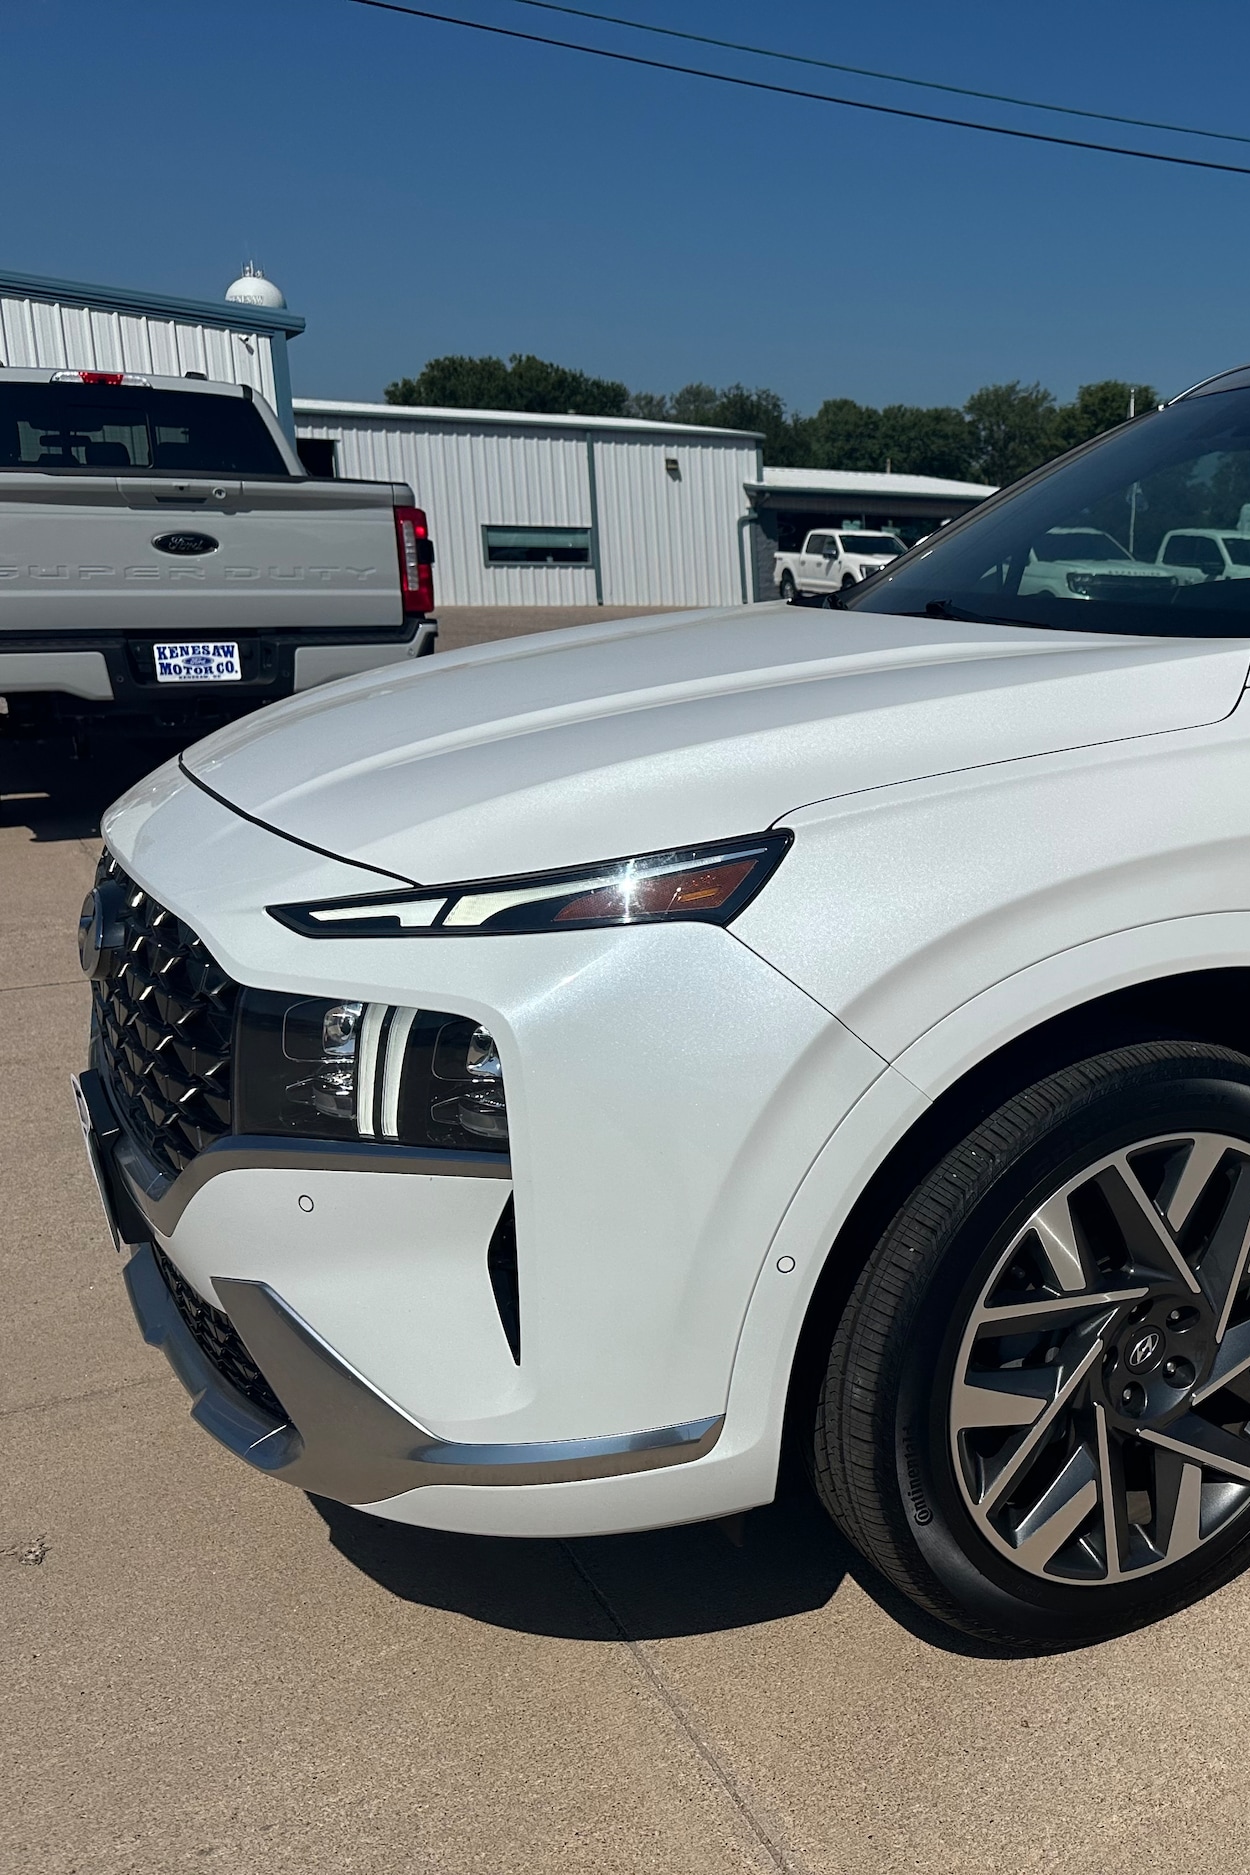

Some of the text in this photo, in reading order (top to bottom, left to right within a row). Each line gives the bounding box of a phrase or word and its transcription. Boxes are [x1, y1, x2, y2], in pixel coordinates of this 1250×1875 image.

[168, 536, 204, 550] Ford
[224, 565, 377, 581] DUTY
[156, 645, 235, 660] KENESAW
[159, 661, 238, 676] MOTOR CO.
[902, 1438, 934, 1527] Continental
